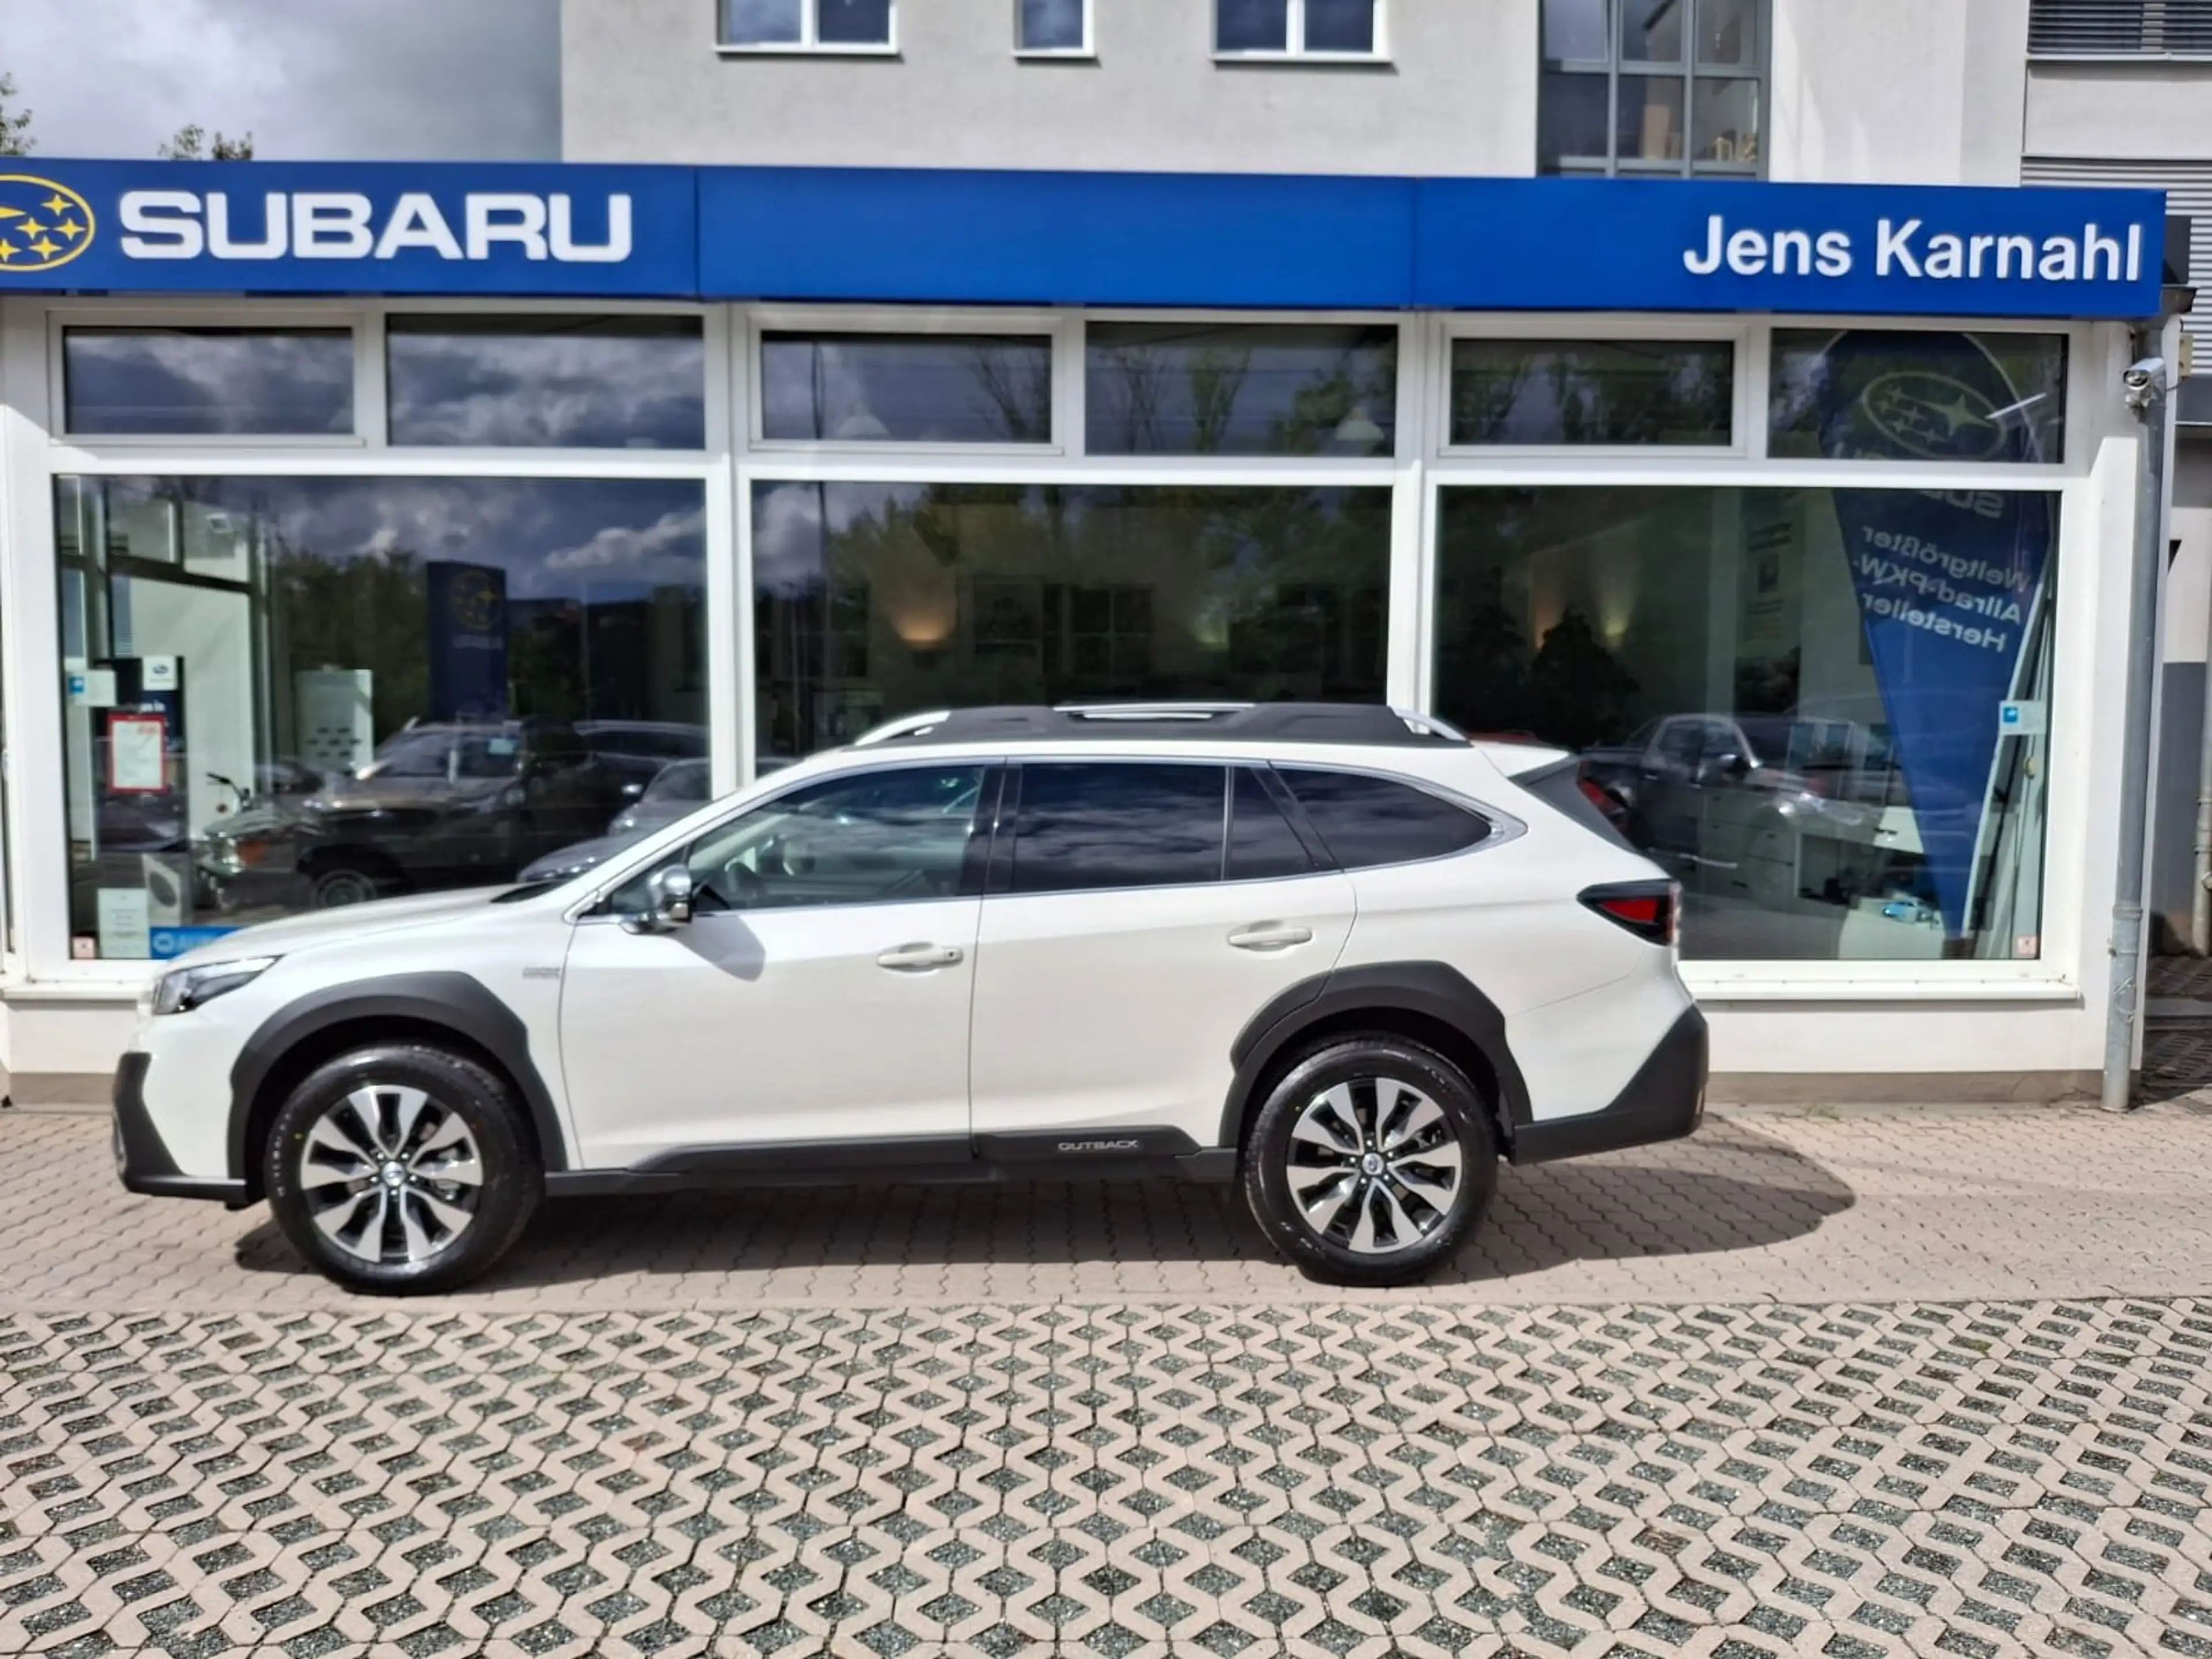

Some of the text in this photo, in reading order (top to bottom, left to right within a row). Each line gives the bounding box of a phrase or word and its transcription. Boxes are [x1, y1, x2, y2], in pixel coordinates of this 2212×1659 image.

[119, 191, 632, 262] SUBARU
[1683, 215, 2141, 281] Jens Karnahl
[1058, 1139, 1139, 1152] OUTBACK
